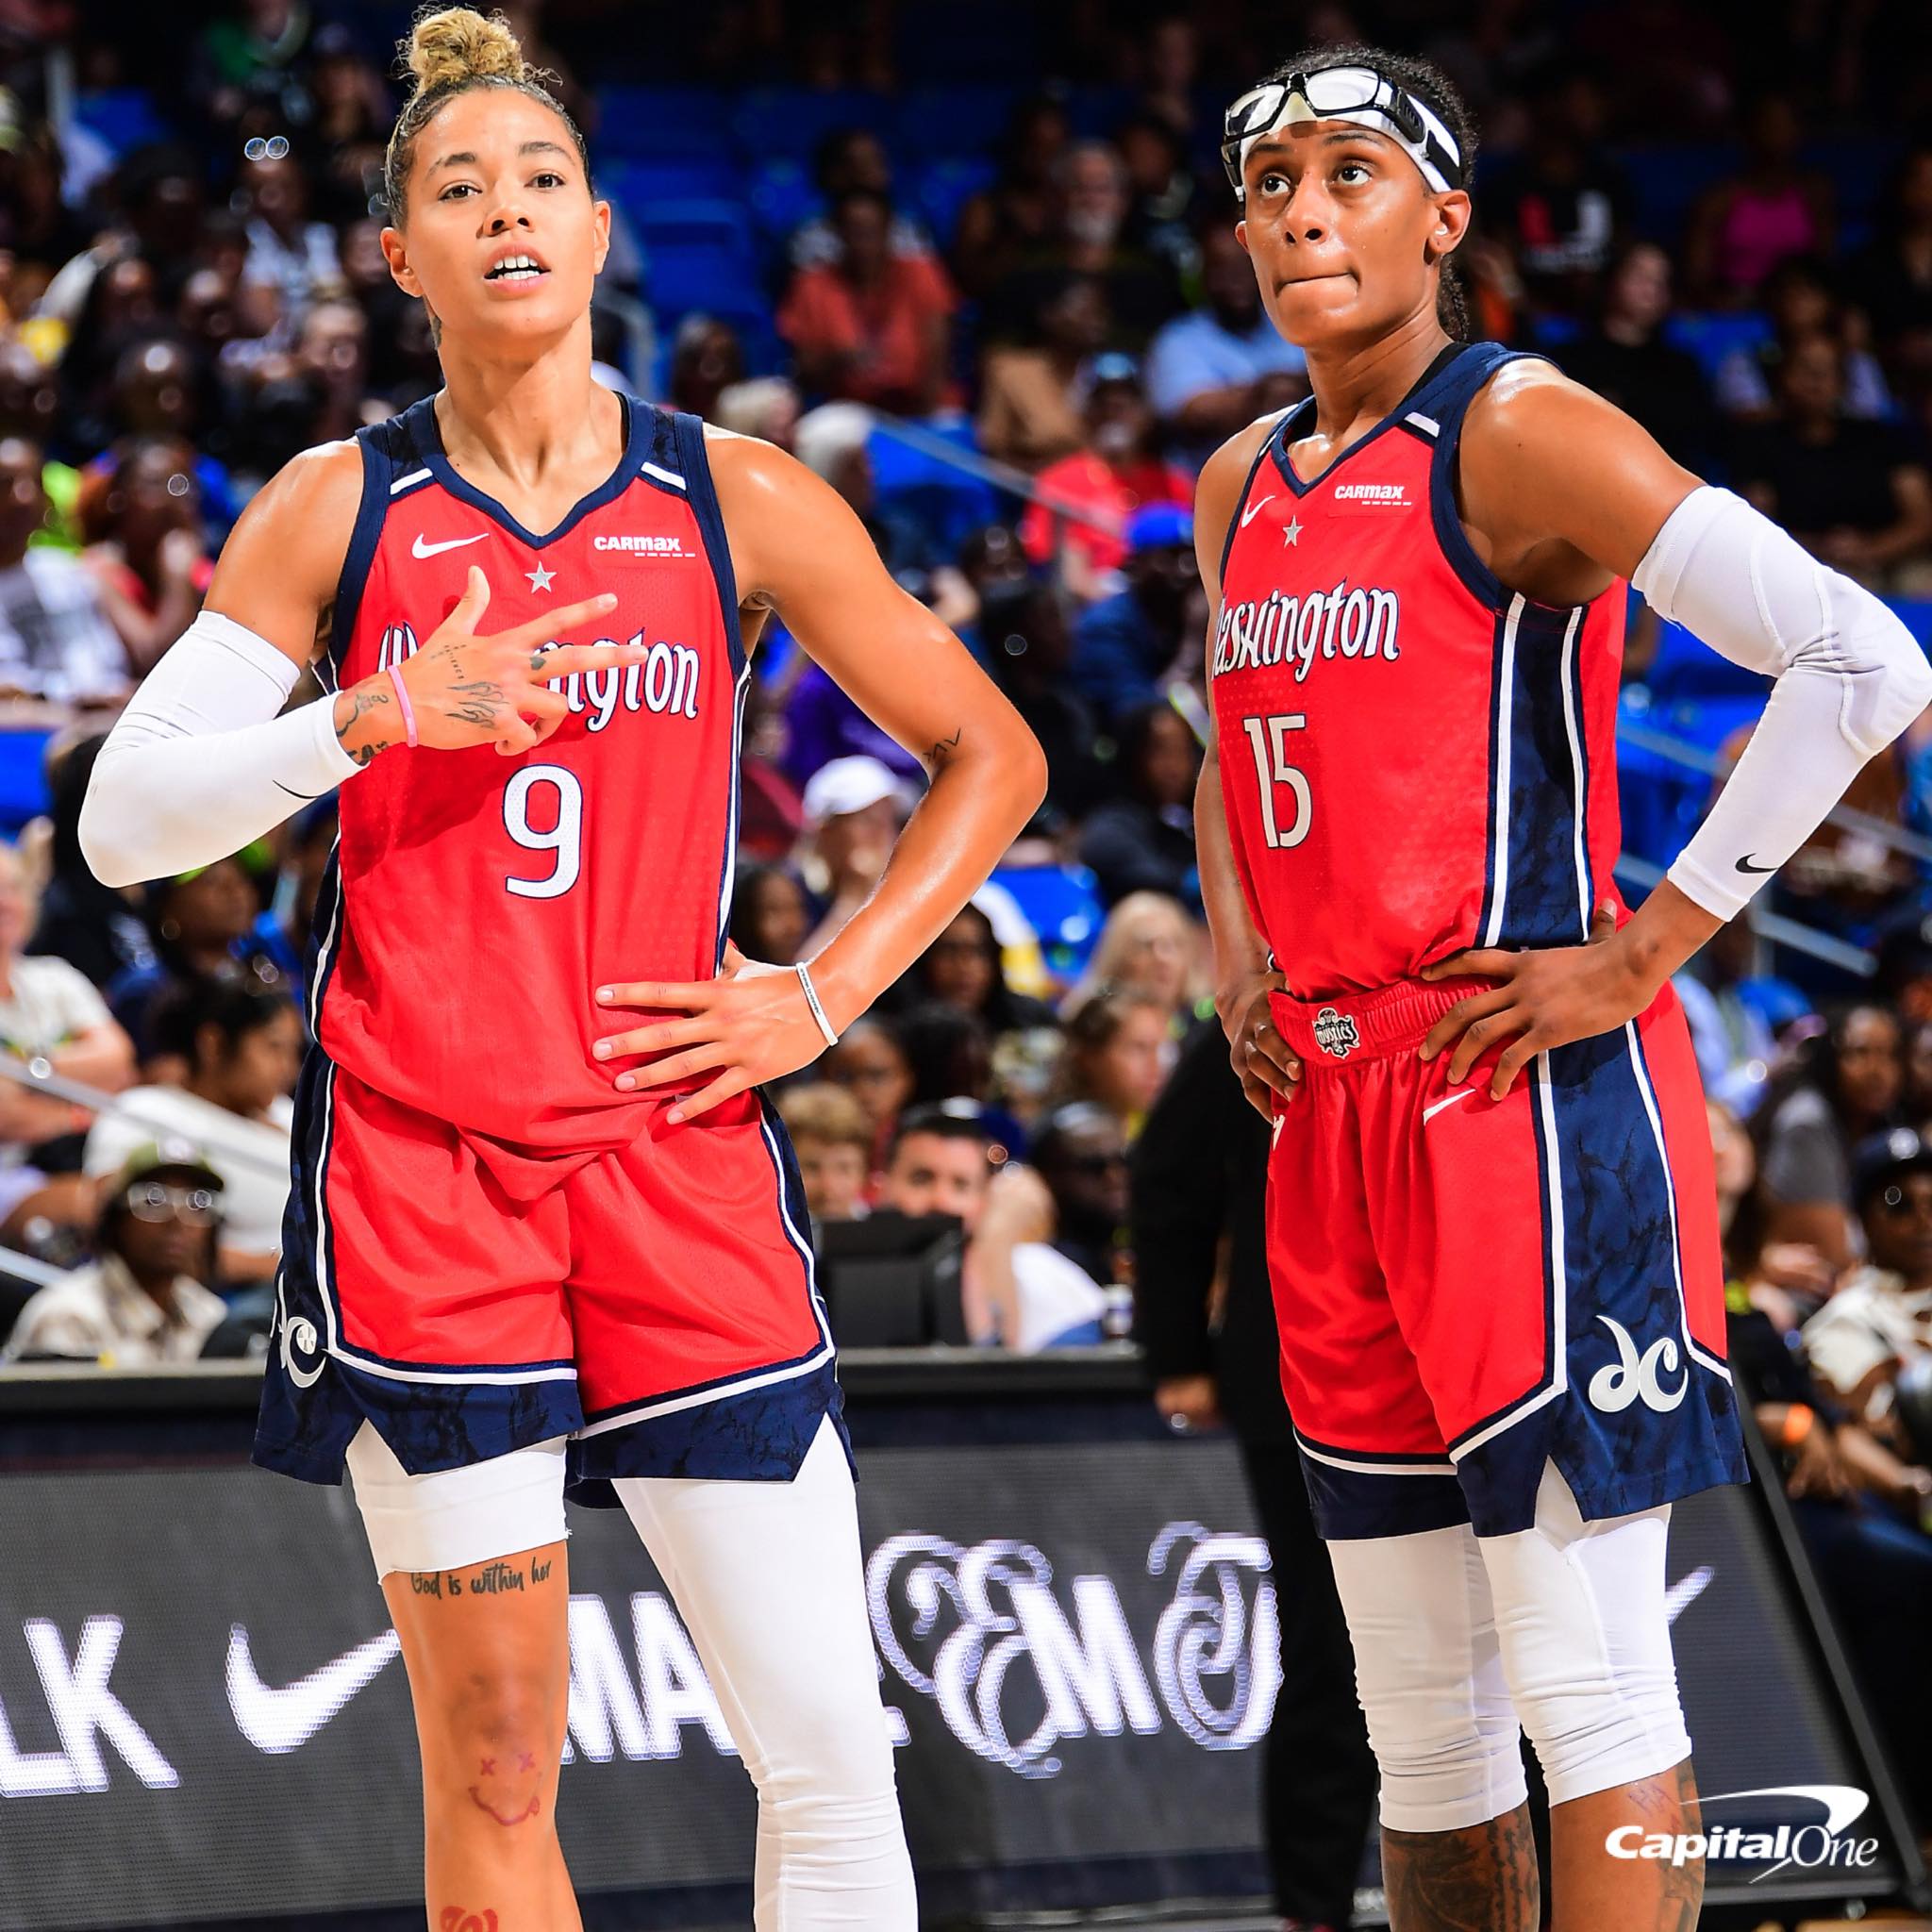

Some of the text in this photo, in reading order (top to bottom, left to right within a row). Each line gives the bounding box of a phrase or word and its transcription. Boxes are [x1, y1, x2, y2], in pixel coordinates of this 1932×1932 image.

[1212, 576, 1401, 683] ashington
[502, 764, 582, 899] 9
[1242, 714, 1313, 849] 15
[411, 1557, 552, 1599] God is within her
